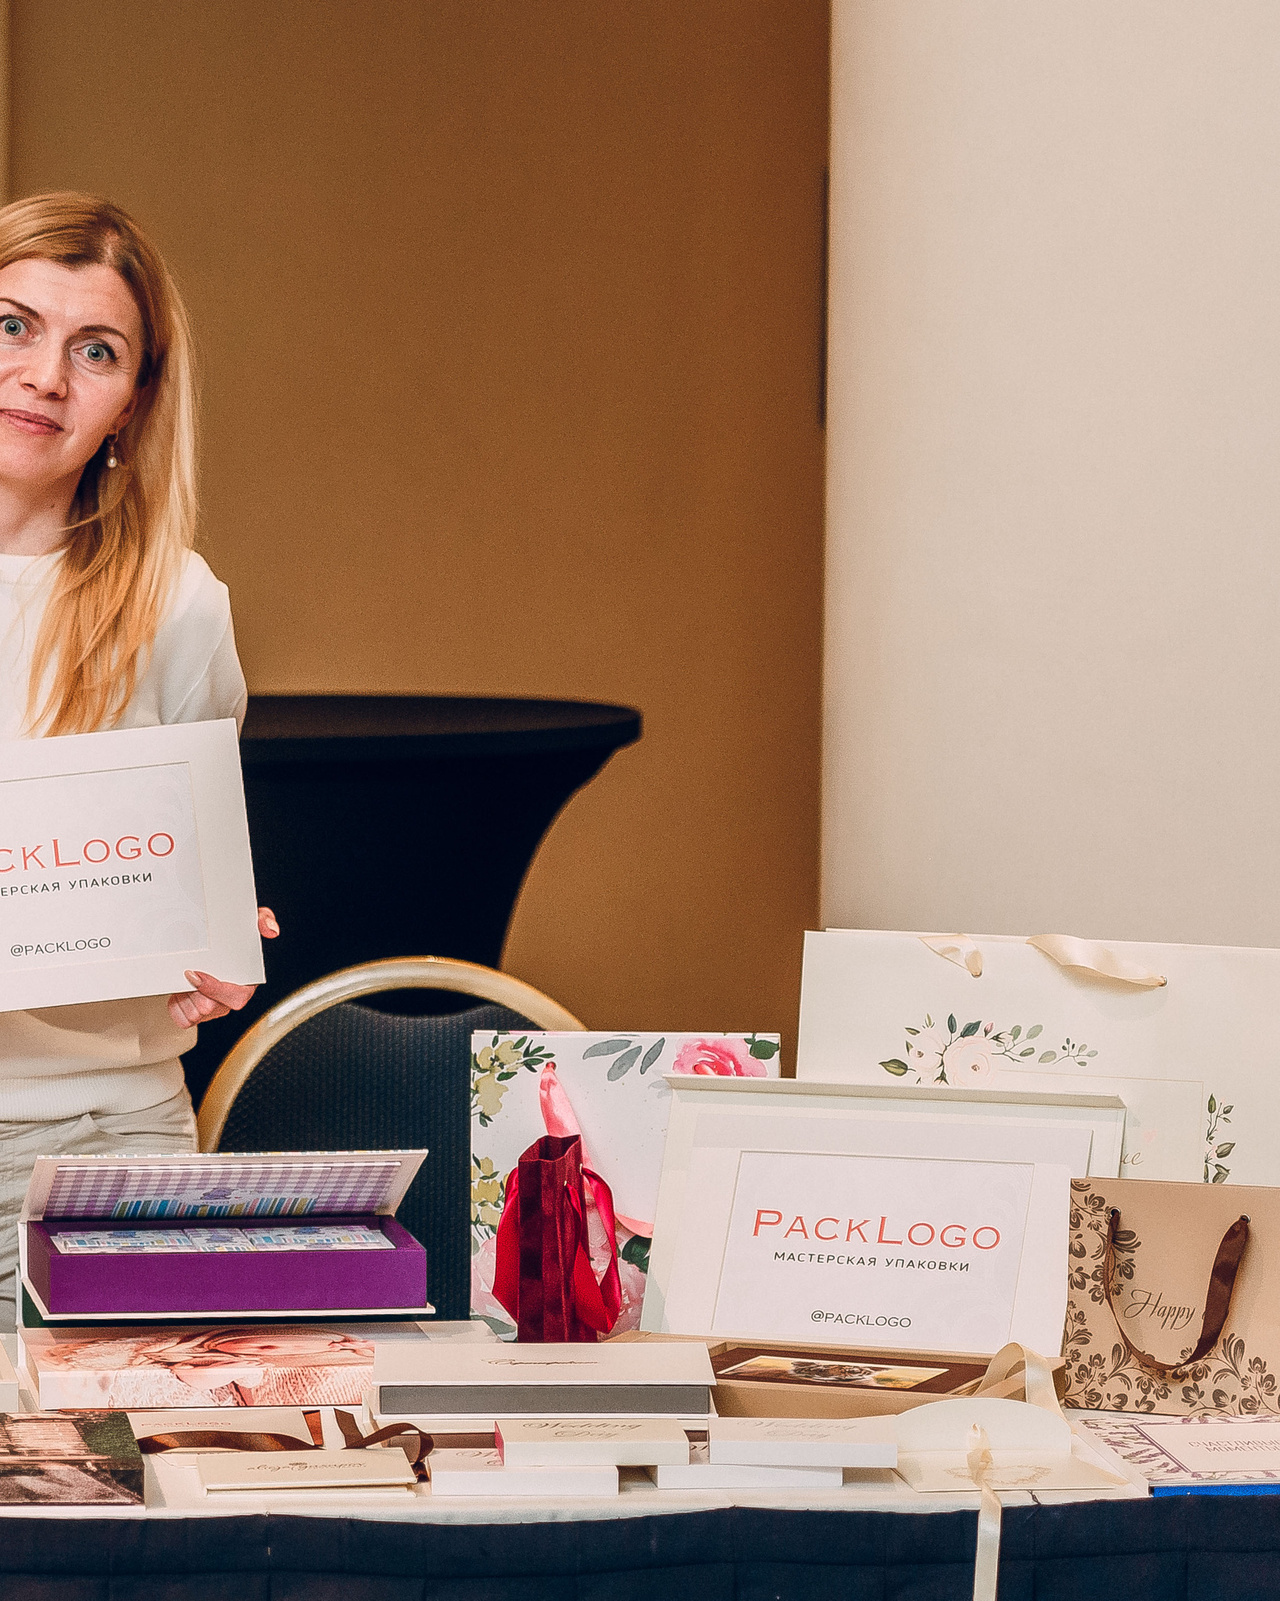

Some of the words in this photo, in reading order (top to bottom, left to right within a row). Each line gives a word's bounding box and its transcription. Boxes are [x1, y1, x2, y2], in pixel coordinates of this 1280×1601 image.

[68, 872, 153, 890] УПАКОВКИ
[10, 937, 111, 957] @PACKLOGO
[773, 1251, 877, 1267] МАСТЕРСКАЯ
[885, 1257, 970, 1272] УПАКОВКИ
[810, 1309, 912, 1328] @PACKLOGO
[1123, 1289, 1196, 1330] Happy
[1188, 1439, 1280, 1448] СЧАСТЛИВЫ
